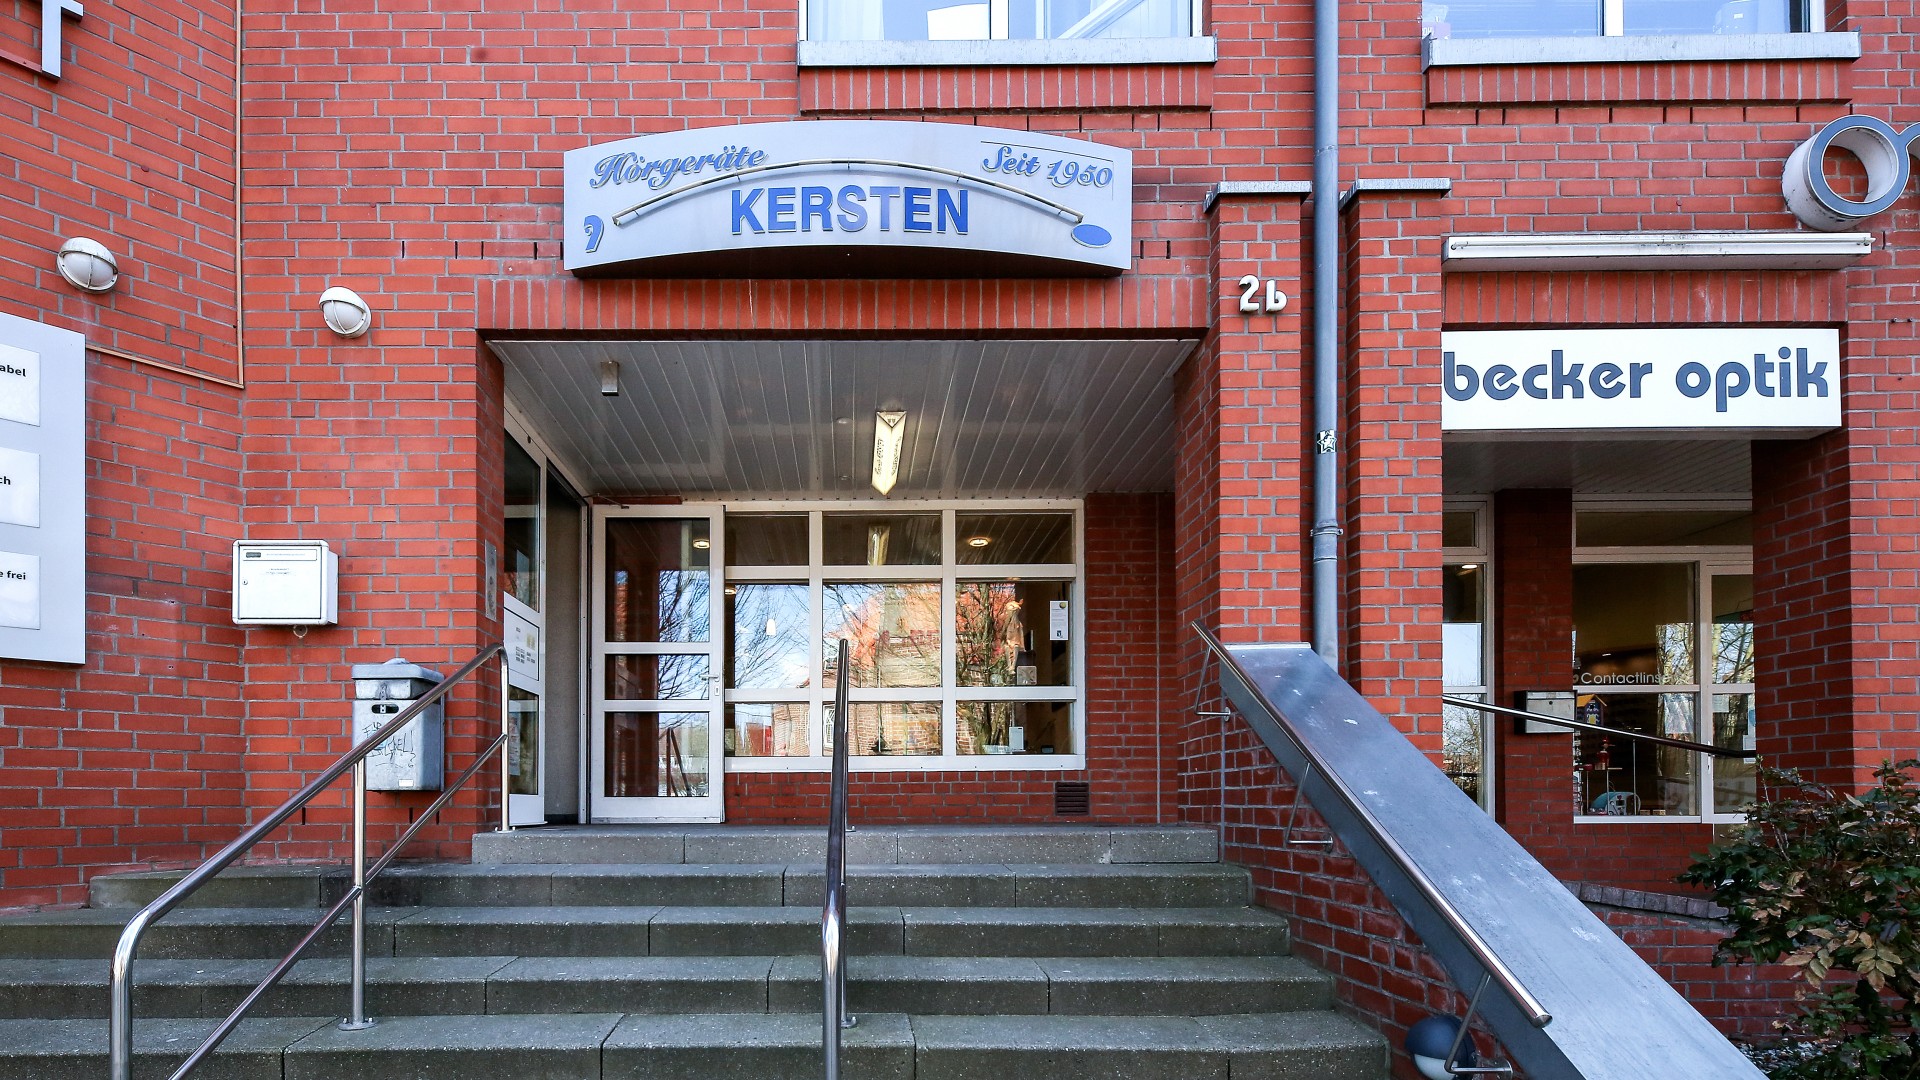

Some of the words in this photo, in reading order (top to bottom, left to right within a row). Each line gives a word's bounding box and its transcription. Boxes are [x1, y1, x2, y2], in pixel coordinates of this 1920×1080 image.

[589, 145, 769, 190] Hörgeräte
[982, 146, 1041, 177] Seit
[1047, 159, 1113, 188] 1950
[731, 184, 969, 235] KERSTEN
[1238, 274, 1288, 312] 2b
[1443, 349, 1653, 401] becker
[1675, 346, 1829, 413] optik
[7, 570, 26, 580] frei
